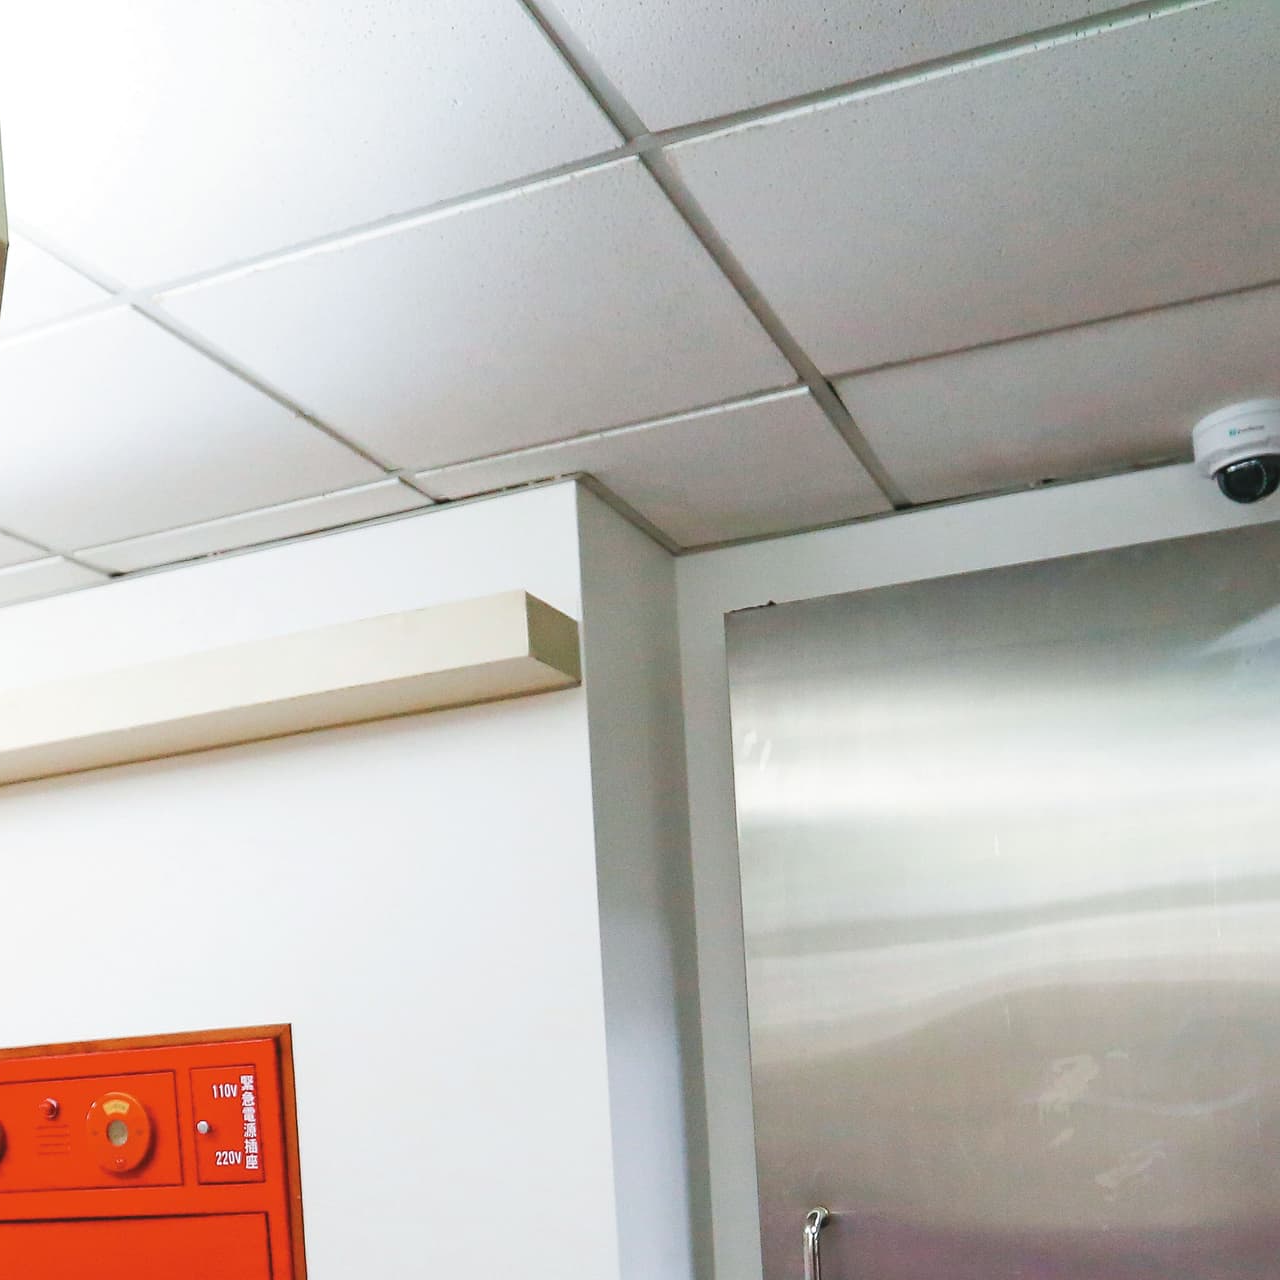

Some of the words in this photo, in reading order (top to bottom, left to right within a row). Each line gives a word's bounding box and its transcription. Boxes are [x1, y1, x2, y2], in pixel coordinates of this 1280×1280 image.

[212, 1084, 238, 1098] 110V
[240, 1075, 259, 1169] 緊急電源插座
[215, 1151, 242, 1166] 220V
